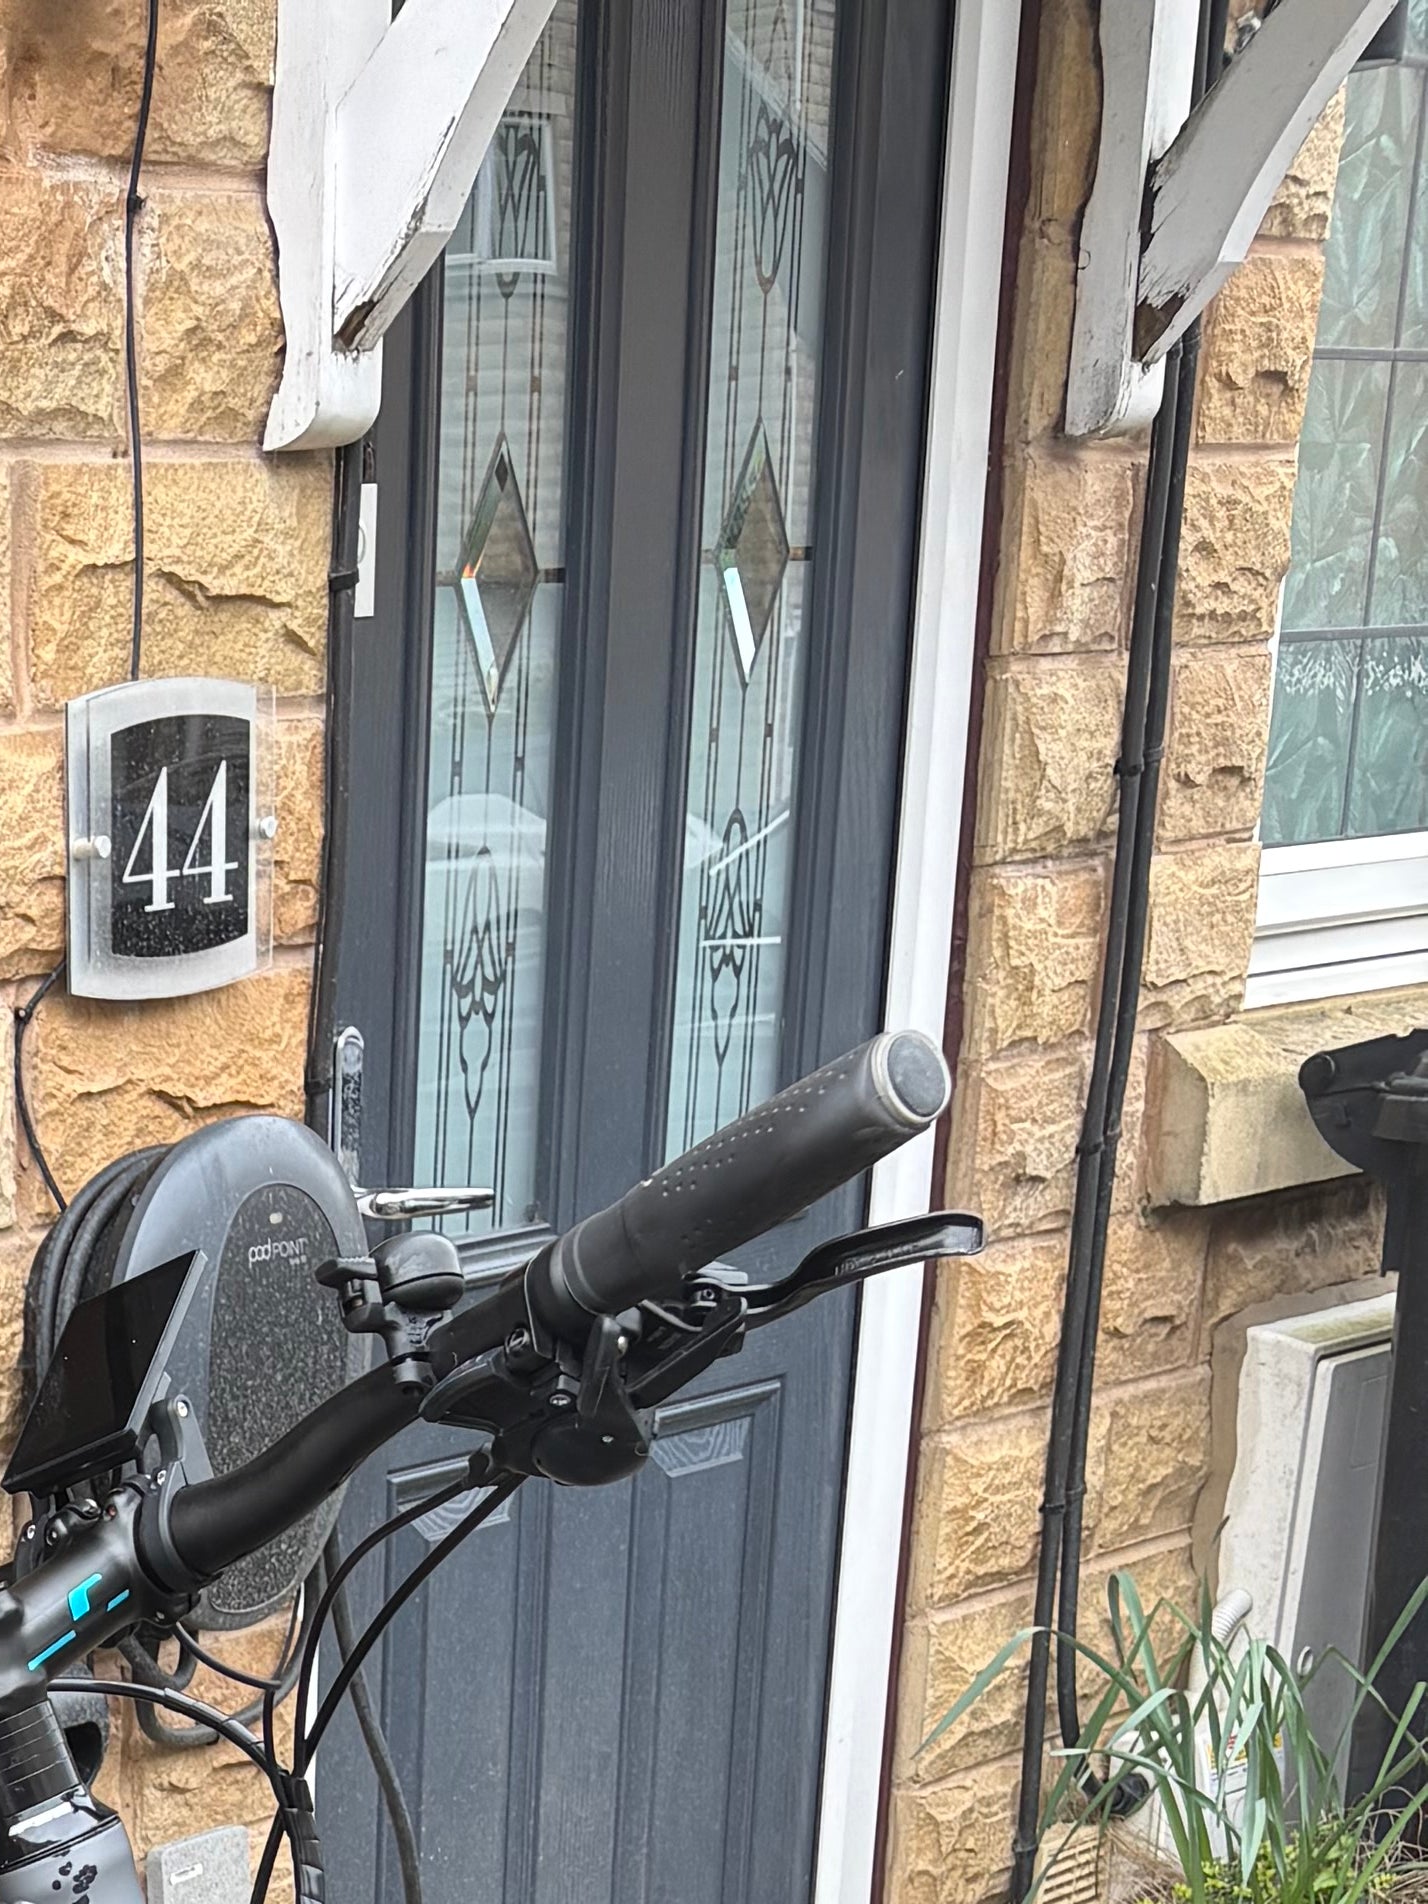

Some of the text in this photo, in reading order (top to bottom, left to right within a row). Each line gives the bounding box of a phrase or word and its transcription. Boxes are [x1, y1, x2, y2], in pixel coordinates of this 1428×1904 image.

[122, 760, 239, 913] 44
[248, 1237, 271, 1269] pod
[272, 1238, 306, 1260] POINT
